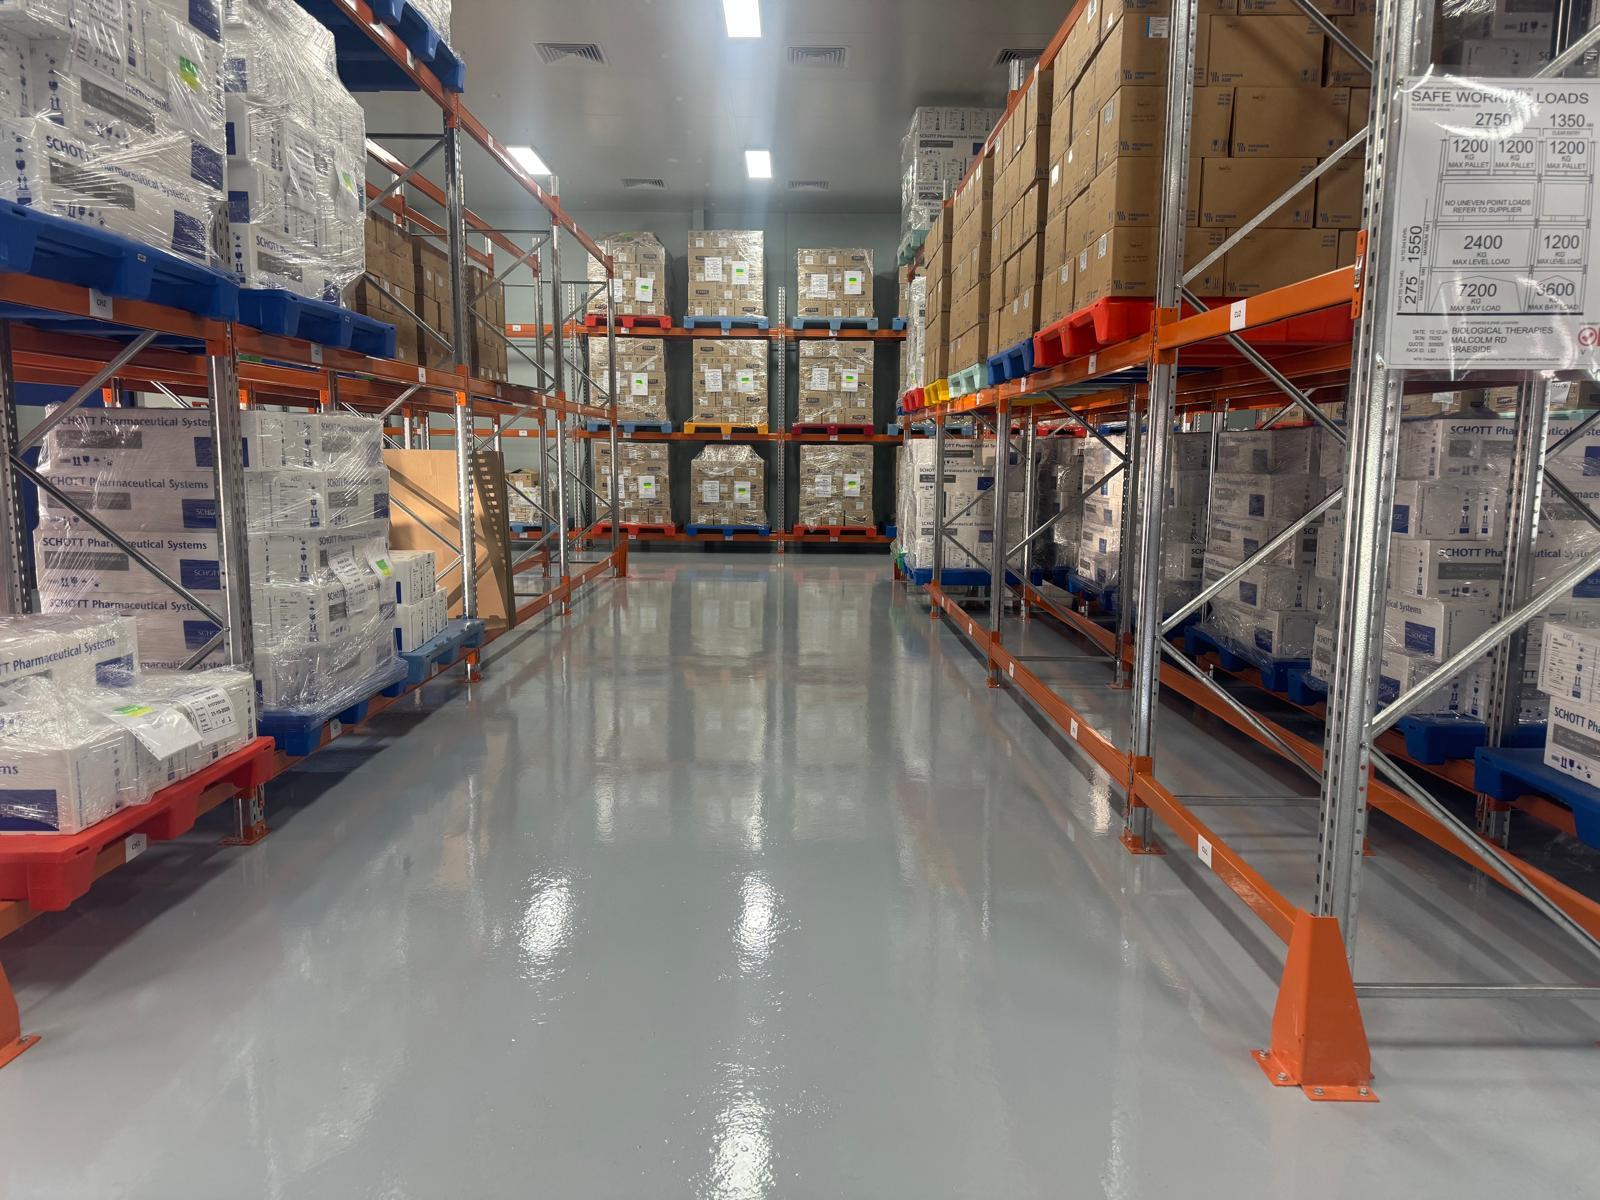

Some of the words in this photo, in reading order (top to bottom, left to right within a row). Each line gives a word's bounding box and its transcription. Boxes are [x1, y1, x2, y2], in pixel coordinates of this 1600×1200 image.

[1411, 90, 1451, 102] SAFE
[1456, 91, 1532, 104] WORK
[1536, 92, 1589, 104] LOADS
[1475, 112, 1512, 126] 2750
[1550, 113, 1585, 127] 1350
[1452, 139, 1489, 153] 1200
[1498, 139, 1534, 154] 1200
[1549, 140, 1586, 154] 1200
[1408, 226, 1422, 263] 1550
[1464, 235, 1503, 250] 2400
[1544, 234, 1580, 248] 1200
[1404, 276, 1418, 304] 275
[1459, 284, 1498, 297] 7200
[1452, 326, 1502, 334] BIOLOGICAL
[1505, 326, 1554, 334] THERAPIES
[100, 416, 178, 426] Pharmaceutical
[182, 417, 211, 428] Syste
[1450, 426, 1493, 435] SCHOTT
[169, 479, 208, 490] Systems
[1303, 528, 1318, 536] SCH
[43, 537, 84, 546] SCHOTT
[88, 538, 164, 549] Pharceutical
[167, 540, 208, 552] Systems
[319, 536, 337, 546] SCHOTT
[1438, 548, 1484, 558] SCHOTT
[92, 600, 167, 610] Pharmaceutical
[170, 602, 199, 612] Syste
[1400, 602, 1422, 615] Systems
[13, 644, 82, 672] Pharmaceutical
[84, 637, 116, 655] Systems
[1554, 706, 1586, 728] SCHOTT
